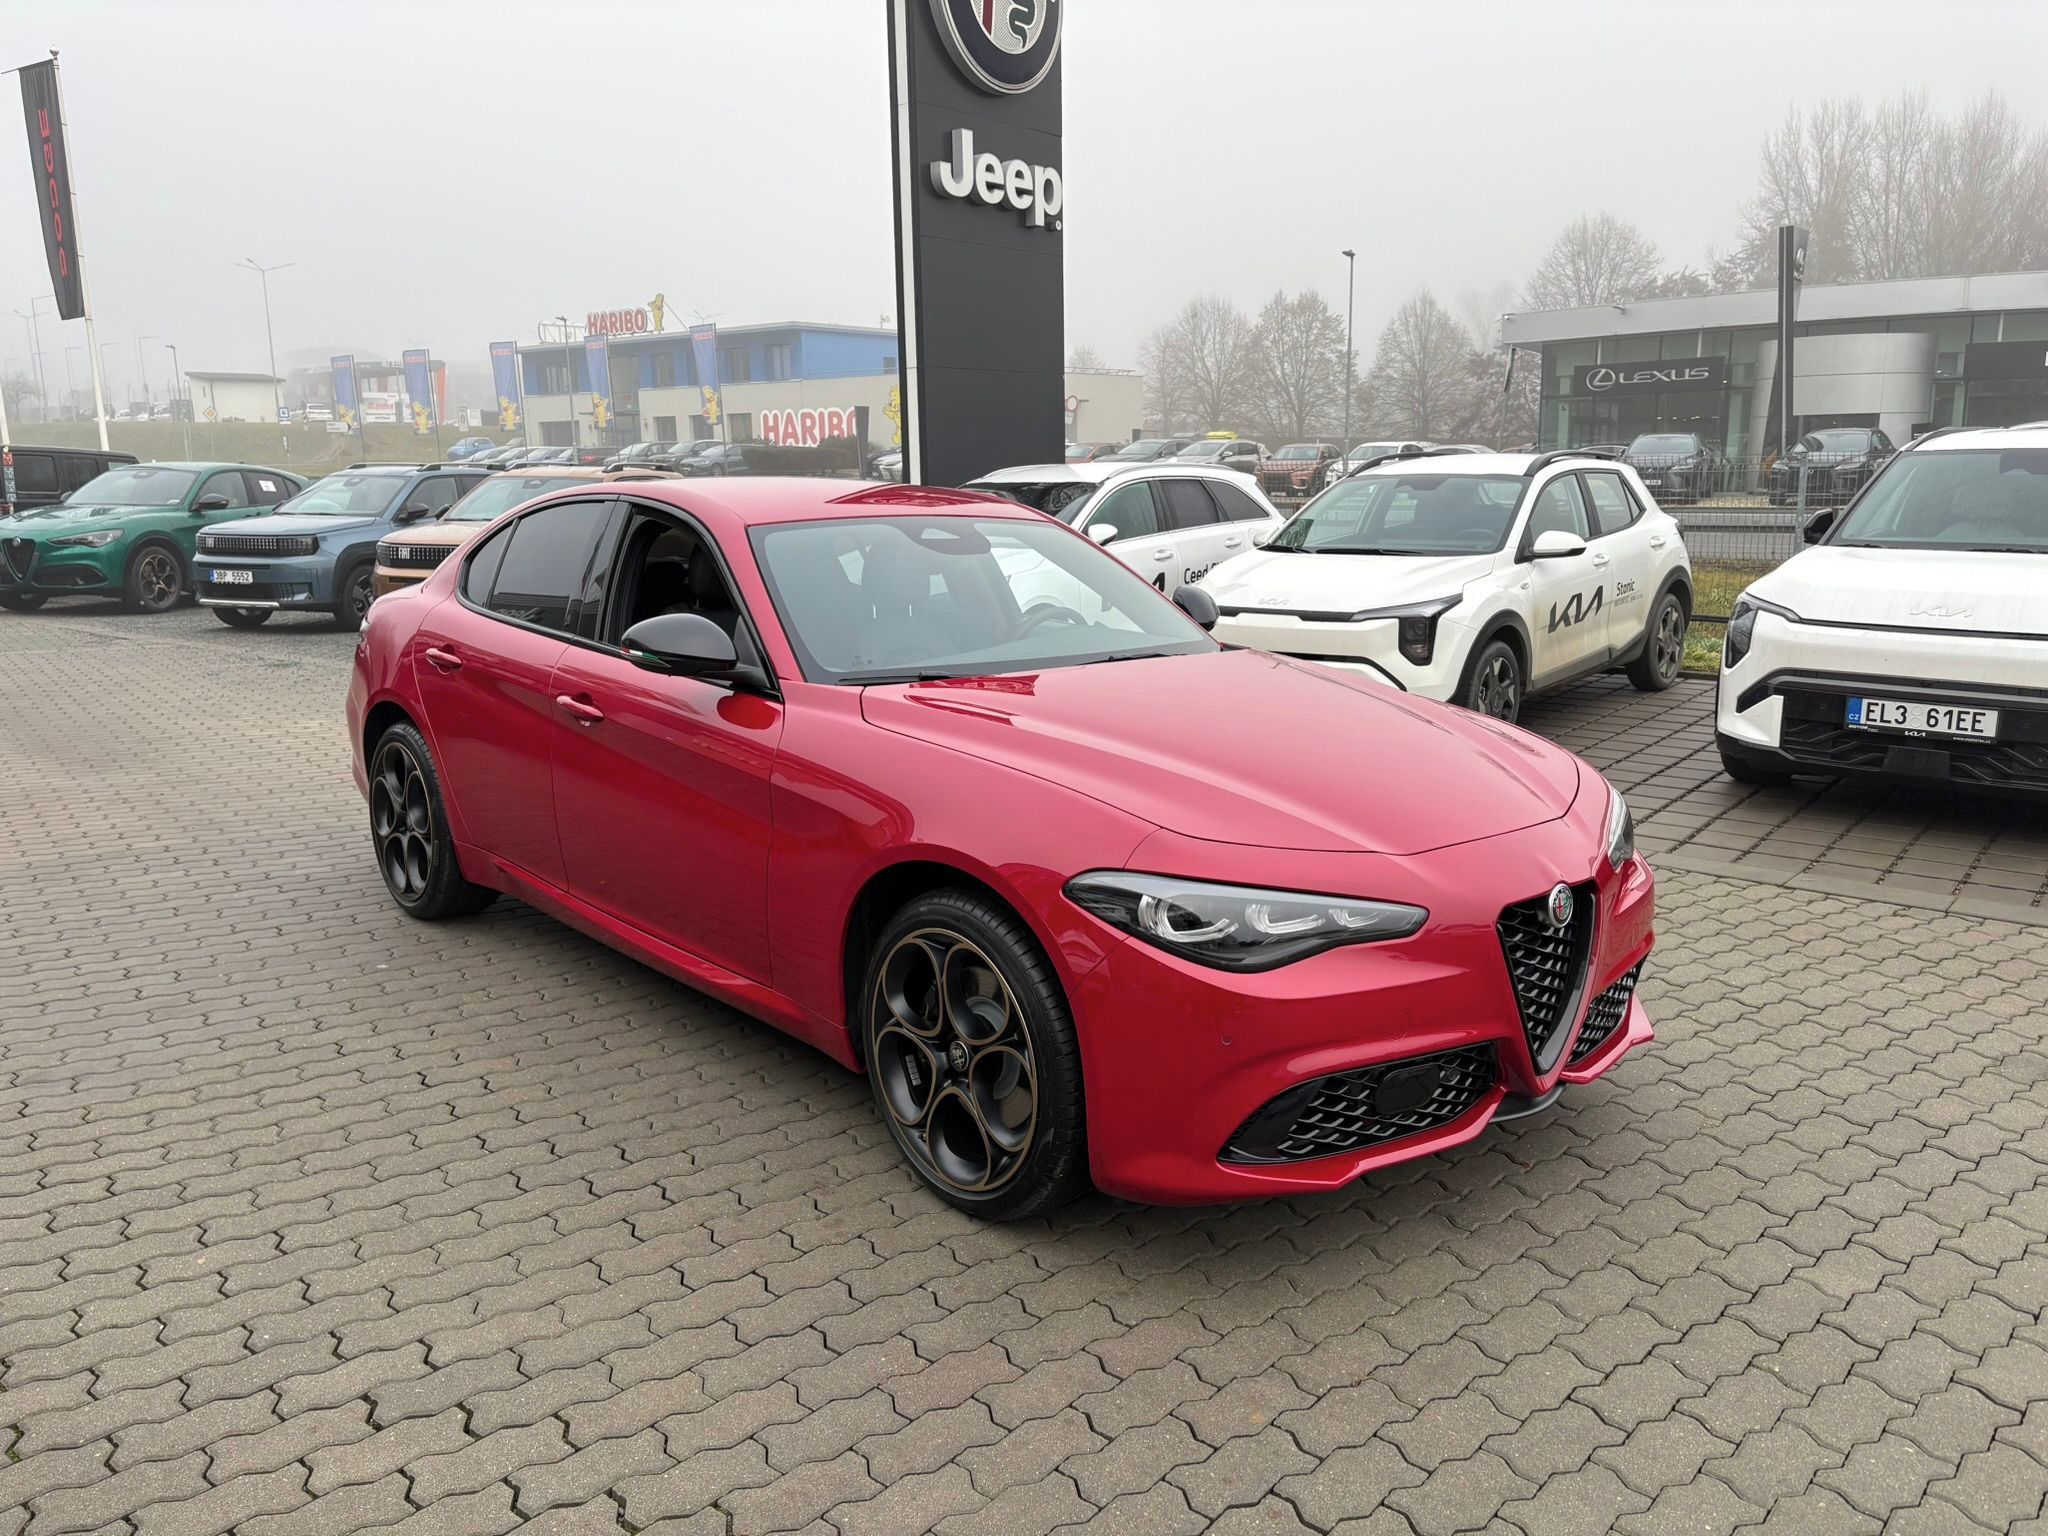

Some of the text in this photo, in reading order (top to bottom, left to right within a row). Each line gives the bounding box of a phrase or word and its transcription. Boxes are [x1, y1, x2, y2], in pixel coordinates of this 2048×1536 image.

[929, 127, 1063, 228] Jeep
[586, 307, 647, 337] HARIBO
[1618, 367, 1710, 384] LEXUS
[398, 547, 411, 560] FIAT
[1616, 578, 1636, 597] Stonic
[1547, 584, 1604, 634] KIA
[1848, 712, 1860, 721] CZ
[1865, 701, 1987, 734] EL3 61EE
